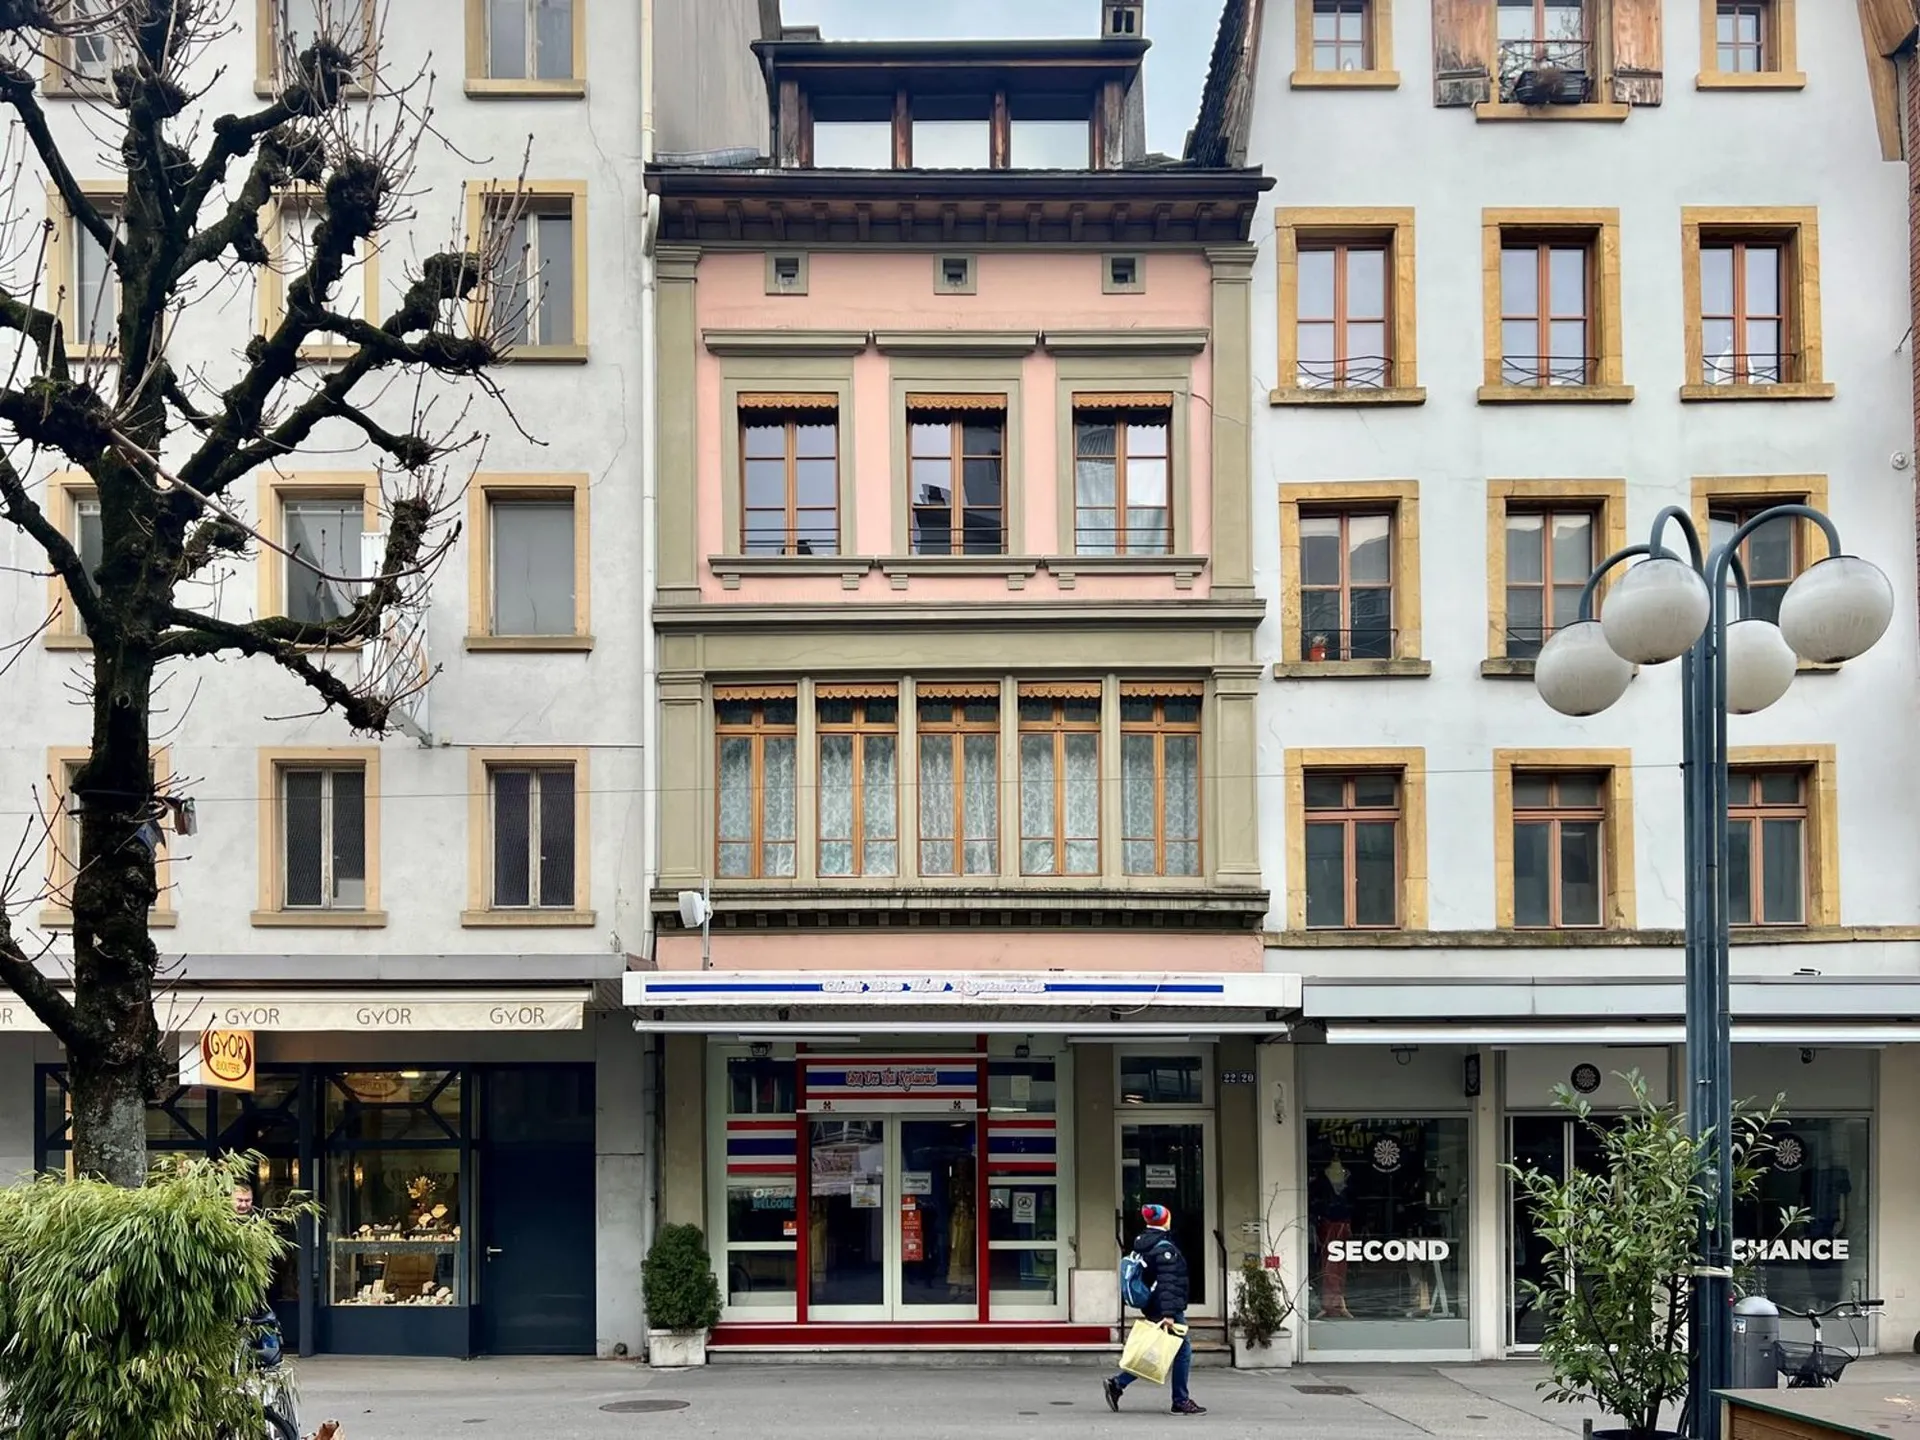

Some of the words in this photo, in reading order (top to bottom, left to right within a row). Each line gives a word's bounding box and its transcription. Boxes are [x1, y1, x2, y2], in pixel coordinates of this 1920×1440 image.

[225, 1008, 280, 1025] GYOR
[356, 1007, 412, 1025] GYOR
[489, 1007, 545, 1025] GYOR
[210, 1030, 244, 1060] GYOR
[1223, 1073, 1236, 1083] 22
[1241, 1073, 1254, 1083] 20
[753, 1188, 796, 1199] OPEN
[753, 1198, 796, 1209] WELCOME
[1327, 1240, 1449, 1262] SECOND
[1732, 1239, 1849, 1260] CHANCE
